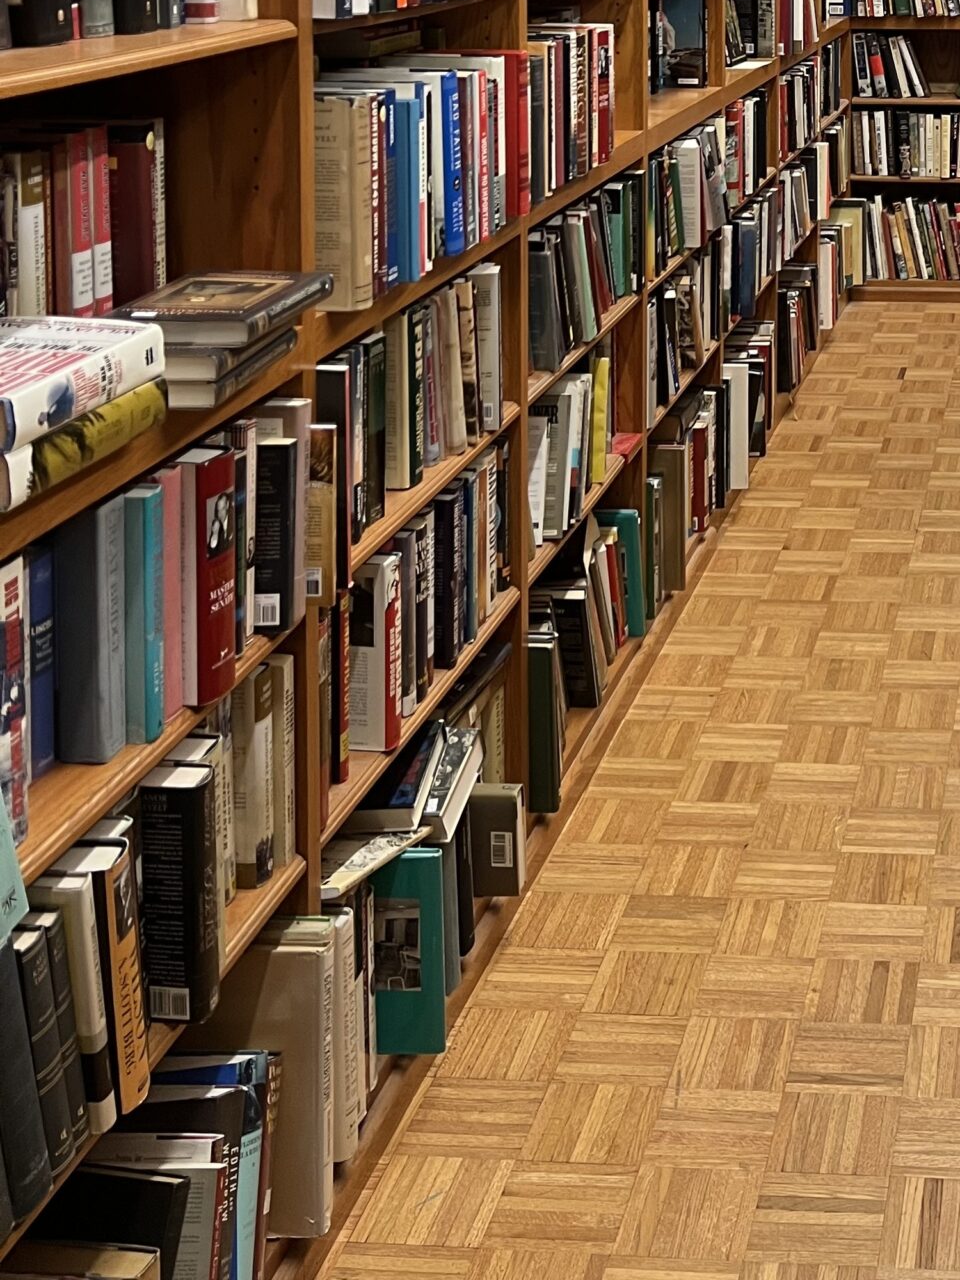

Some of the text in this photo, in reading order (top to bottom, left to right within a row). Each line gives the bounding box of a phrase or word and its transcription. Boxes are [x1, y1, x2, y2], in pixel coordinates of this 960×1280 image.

[451, 92, 460, 121] BAD
[576, 46, 586, 126] SECRECY
[370, 100, 379, 170] COUNTDOWN
[481, 187, 489, 238] IMPORTANCE
[413, 320, 424, 376] FDR
[415, 406, 424, 454] DESTINY
[209, 579, 234, 600] MASTER
[210, 591, 234, 614] SENATE
[110, 582, 119, 654] BRIDGE
[120, 974, 137, 1077] SCOTT BERG
[229, 1146, 239, 1191] EDITH
